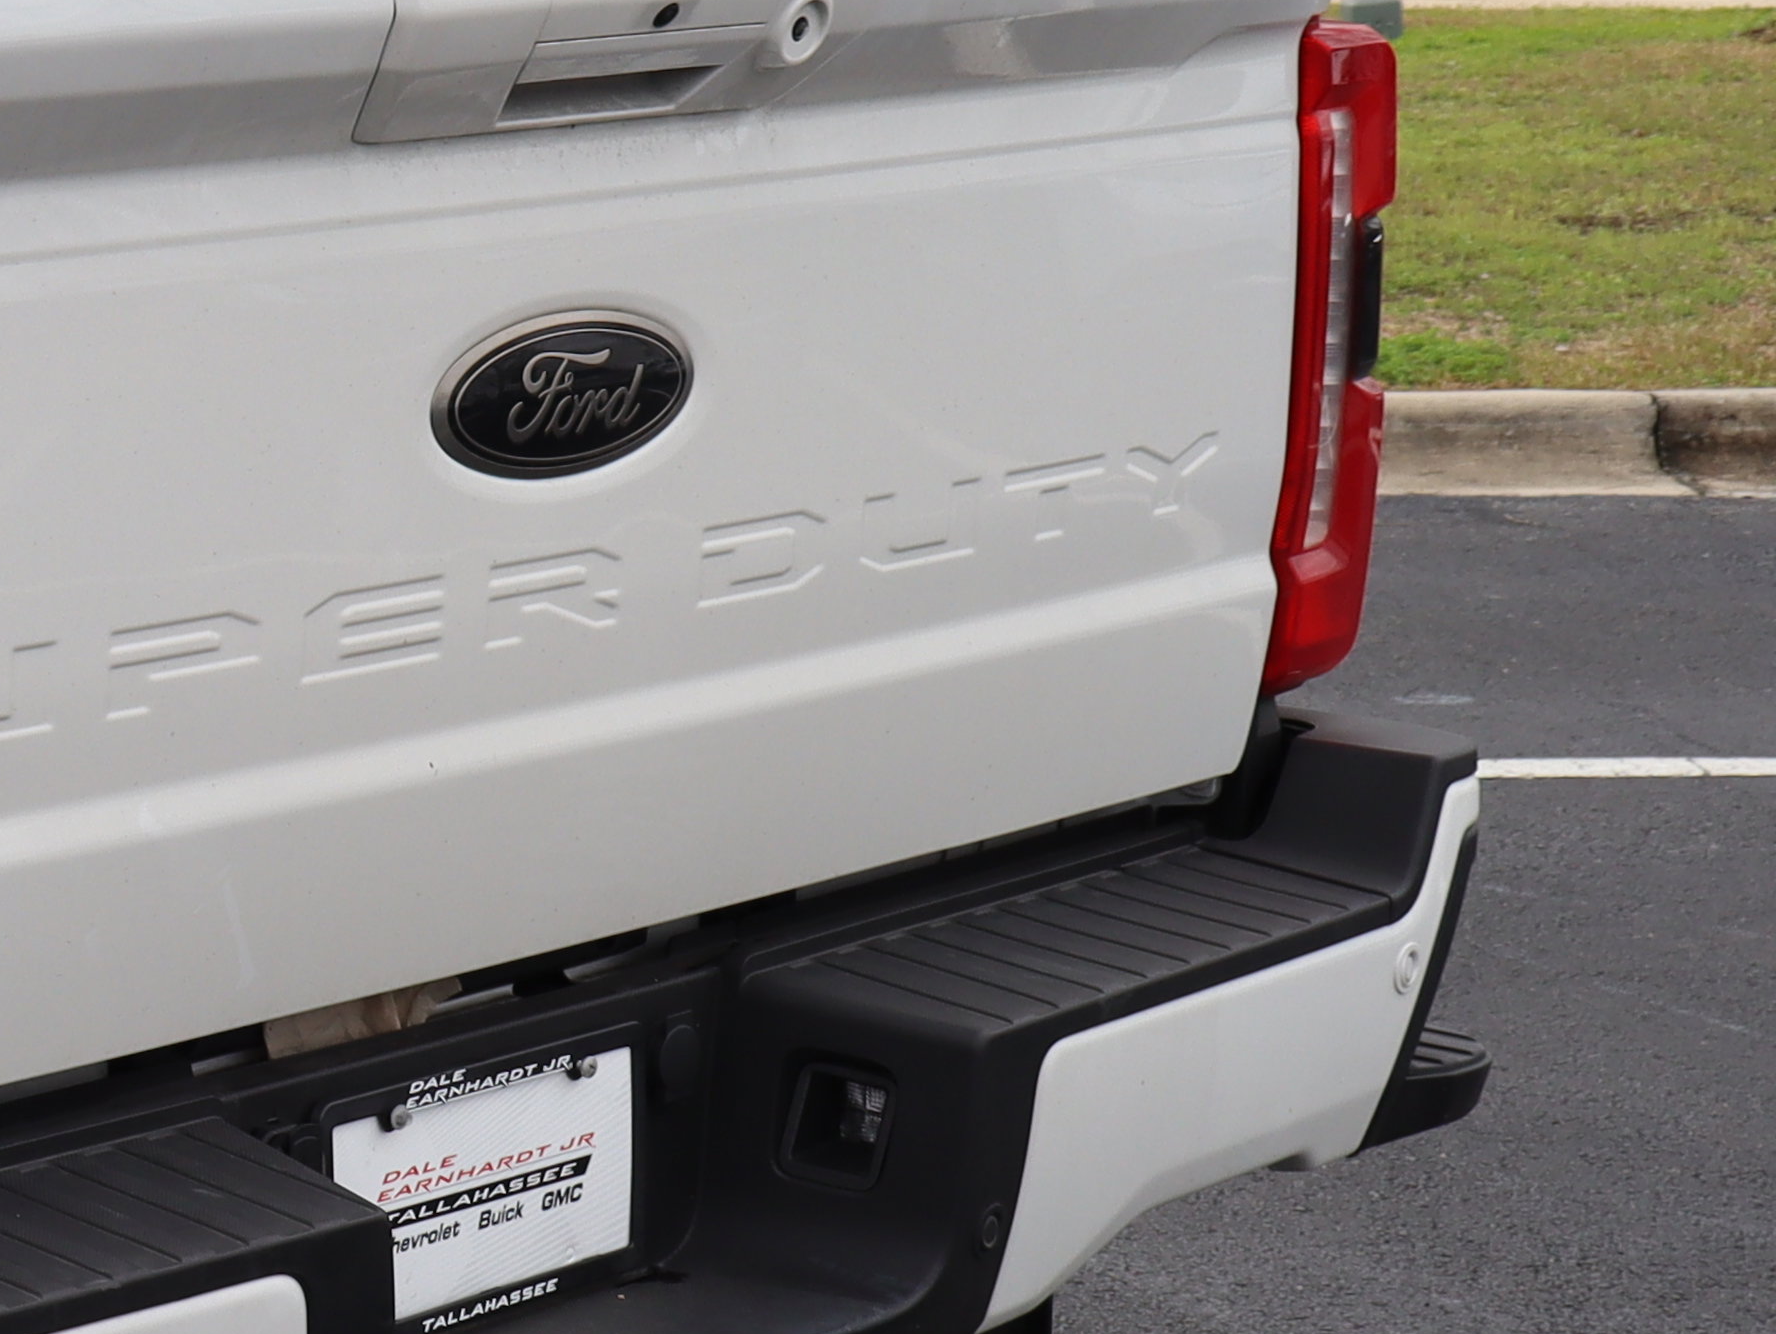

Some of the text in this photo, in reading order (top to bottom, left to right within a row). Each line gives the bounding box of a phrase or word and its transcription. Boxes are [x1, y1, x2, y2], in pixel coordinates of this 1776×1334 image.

[506, 348, 644, 443] Ford
[697, 430, 1219, 607] DUTY
[405, 1063, 538, 1110] EARNHARDT
[409, 1068, 467, 1094] DALE
[377, 1132, 596, 1203] EARNHARDT JR
[382, 1154, 458, 1185] DALE
[388, 1162, 576, 1224] TALLAHASSEE
[392, 1182, 584, 1254] hevrolet Buick GMC
[422, 1278, 559, 1333] TALLAHASSEE
